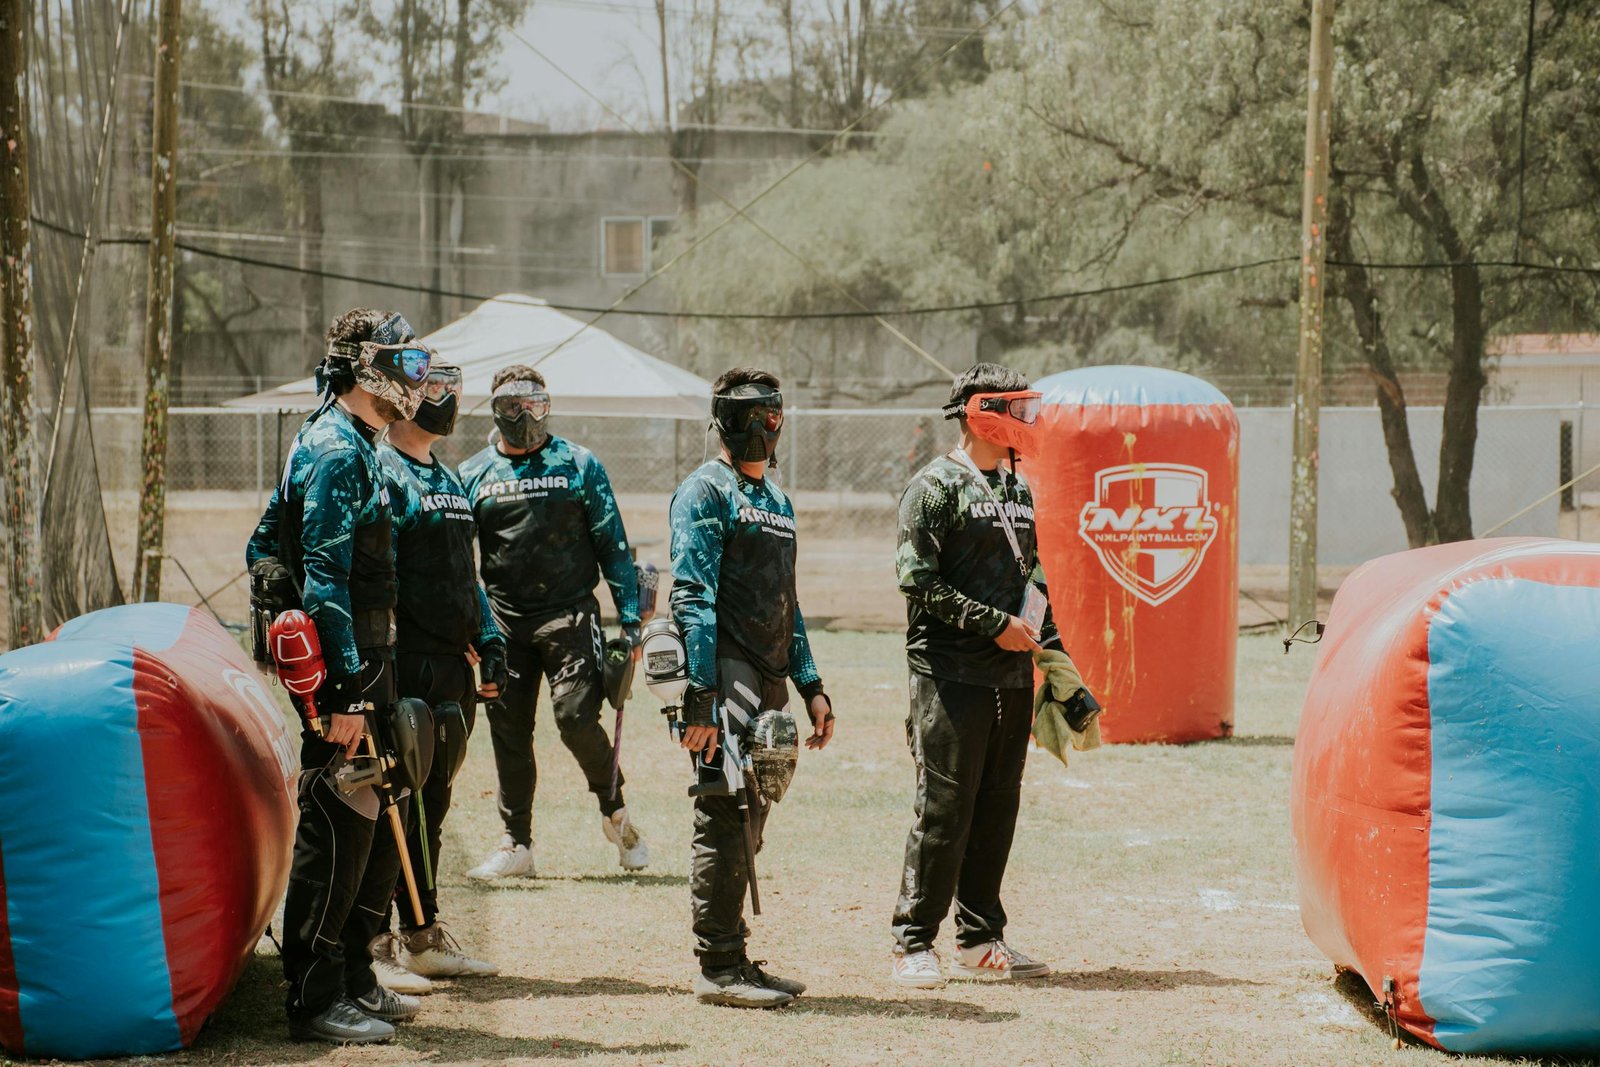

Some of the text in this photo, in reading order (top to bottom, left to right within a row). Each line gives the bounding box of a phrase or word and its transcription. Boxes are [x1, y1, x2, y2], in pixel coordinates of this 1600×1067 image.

[478, 476, 568, 498] KATANIA
[1087, 507, 1215, 531] NXL
[1095, 533, 1209, 544] NXLPAINTBALL.COM
